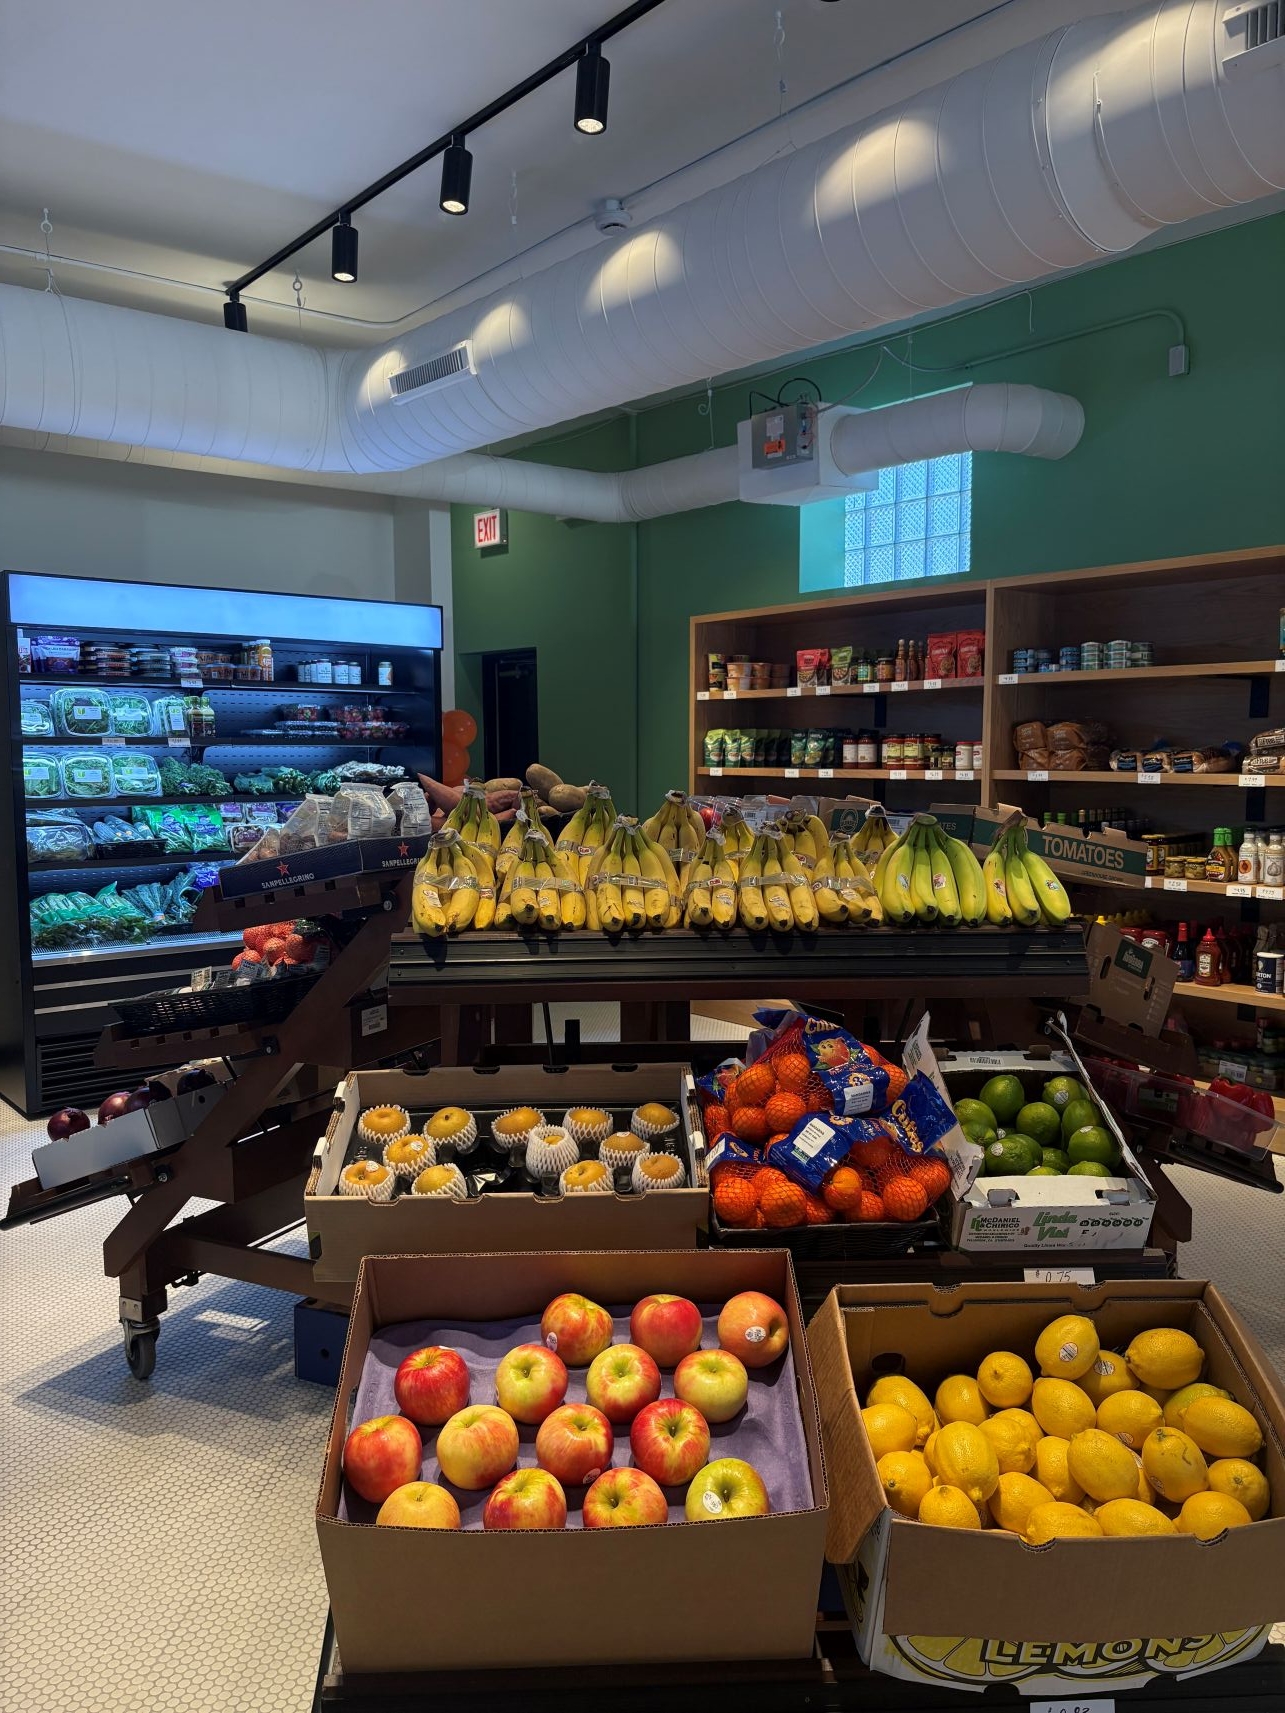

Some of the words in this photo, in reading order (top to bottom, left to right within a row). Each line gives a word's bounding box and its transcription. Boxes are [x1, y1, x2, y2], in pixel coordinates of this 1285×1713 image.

[477, 515, 497, 543] EXIT
[382, 858, 421, 868] SANPELLEGRI
[1042, 835, 1125, 869] TOMATOES
[261, 873, 315, 889] SANPELLEGRINO
[1033, 1211, 1077, 1226] Linda
[983, 1634, 1213, 1664] LEMONS
